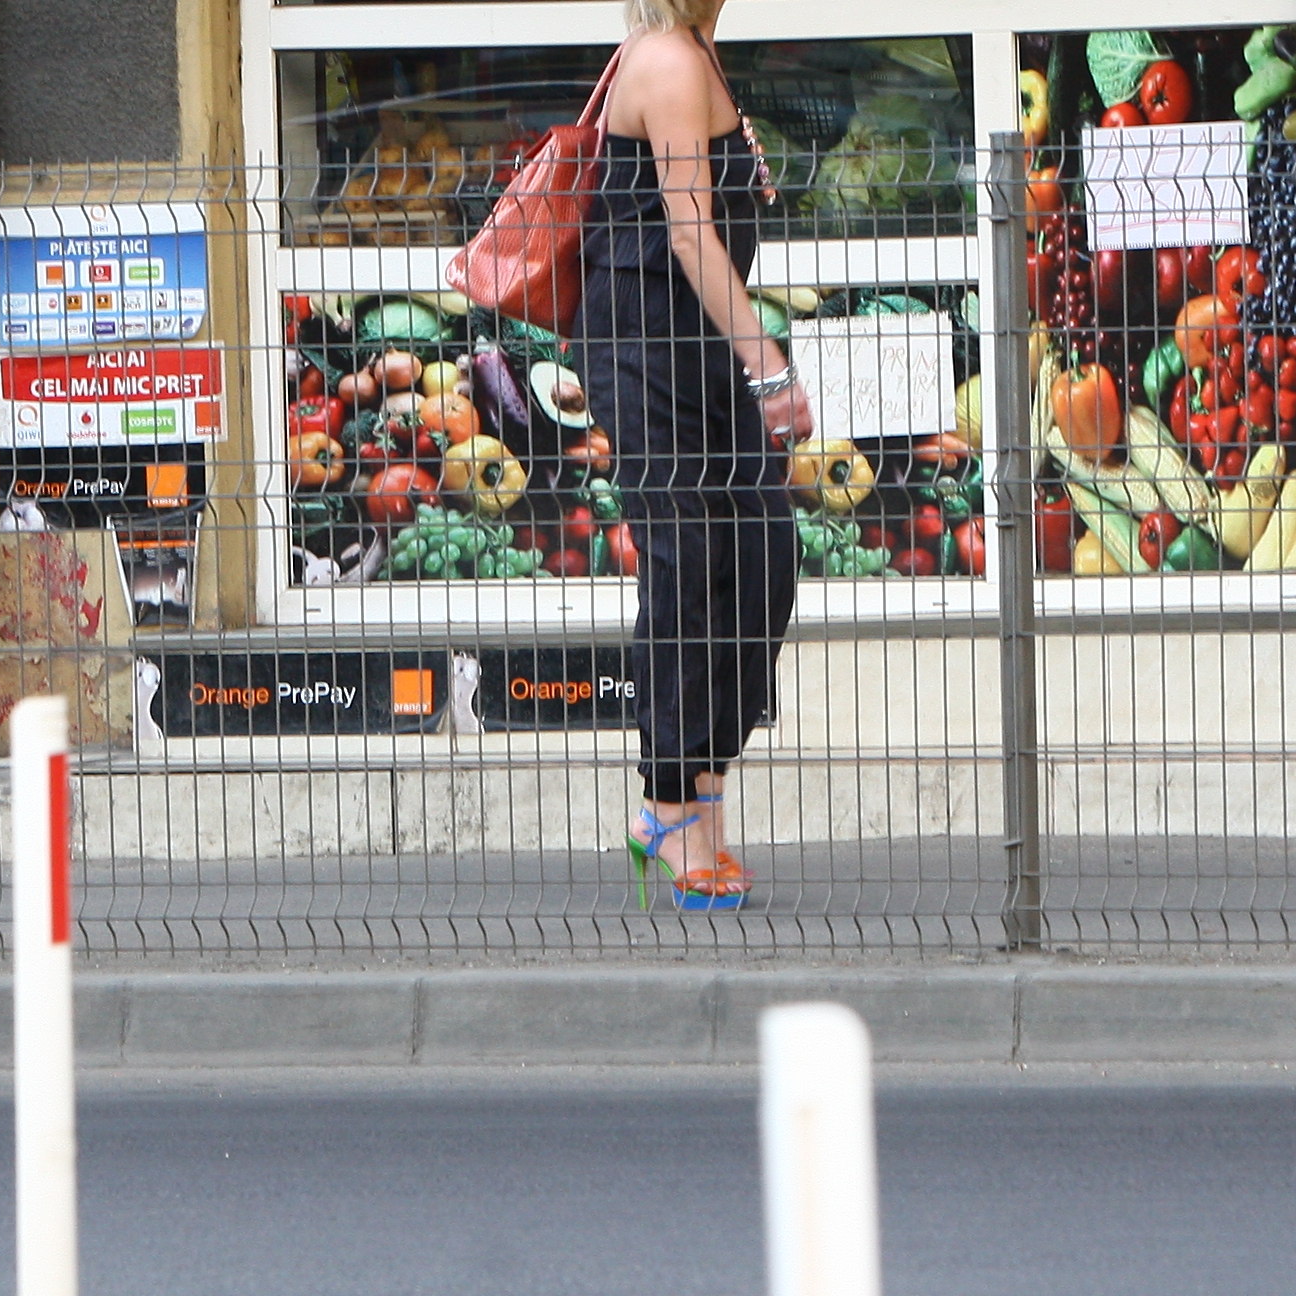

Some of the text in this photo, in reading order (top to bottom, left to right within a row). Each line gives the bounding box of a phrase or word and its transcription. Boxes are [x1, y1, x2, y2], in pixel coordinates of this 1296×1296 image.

[121, 238, 148, 253] AICI
[87, 350, 145, 368] AICI AI
[30, 377, 67, 398] CEL
[71, 376, 108, 396] MAI
[113, 375, 151, 396] MIC
[190, 681, 357, 709] Orange PrePay
[511, 676, 636, 703] Orange Pre
